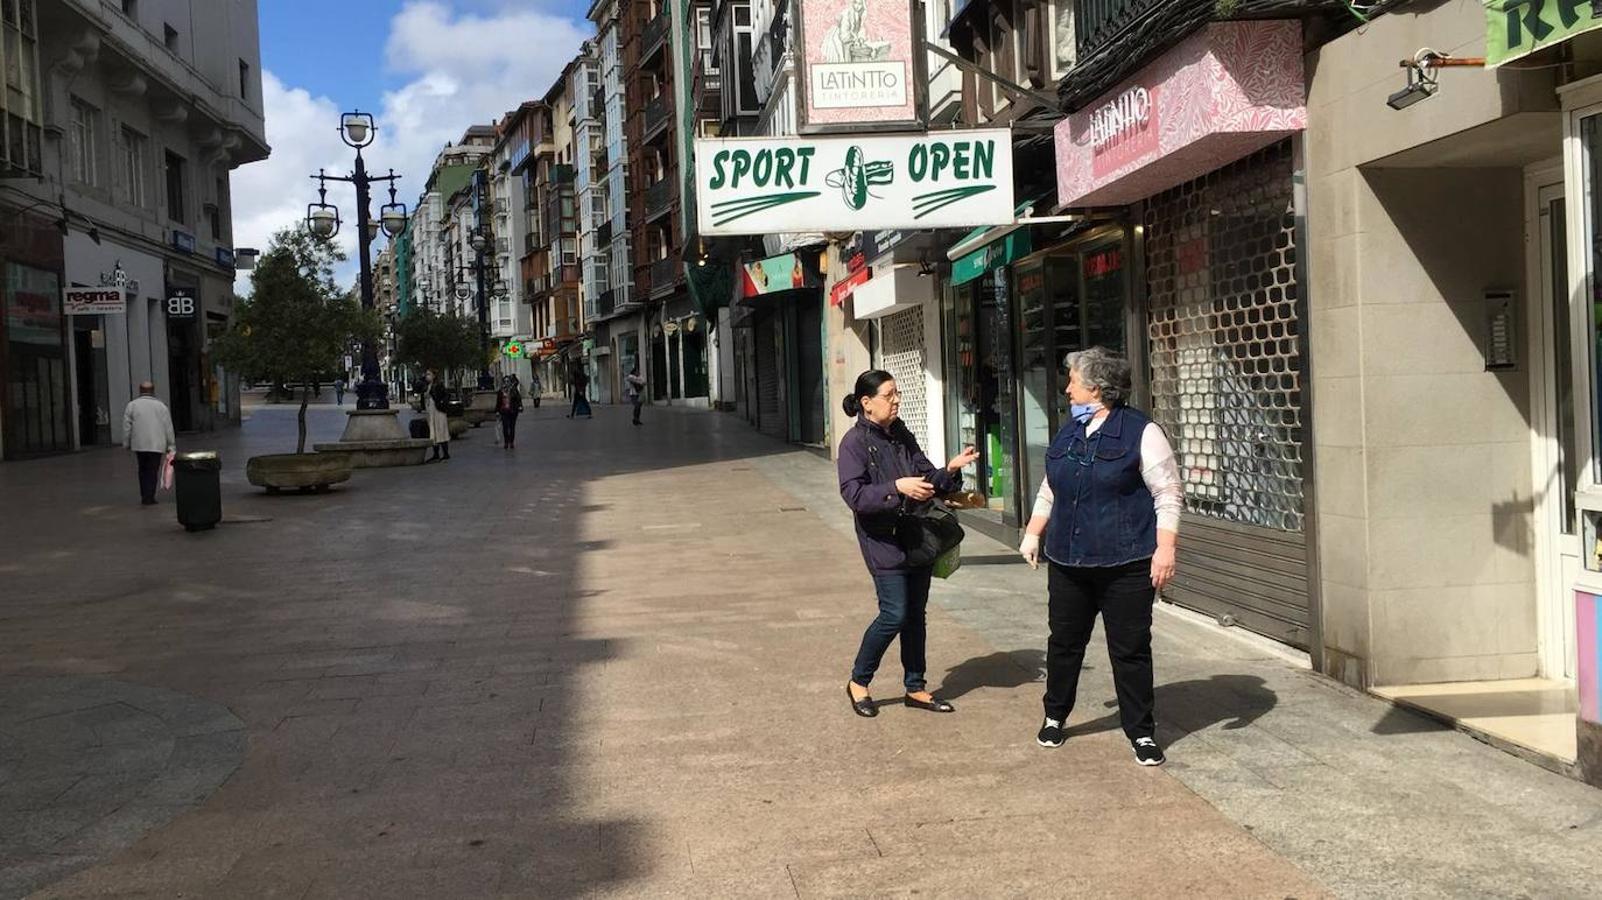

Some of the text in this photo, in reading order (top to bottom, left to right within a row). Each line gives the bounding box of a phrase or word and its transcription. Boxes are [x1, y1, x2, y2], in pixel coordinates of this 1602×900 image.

[709, 139, 995, 190] SPORT OPEN
[66, 290, 120, 304] regma
